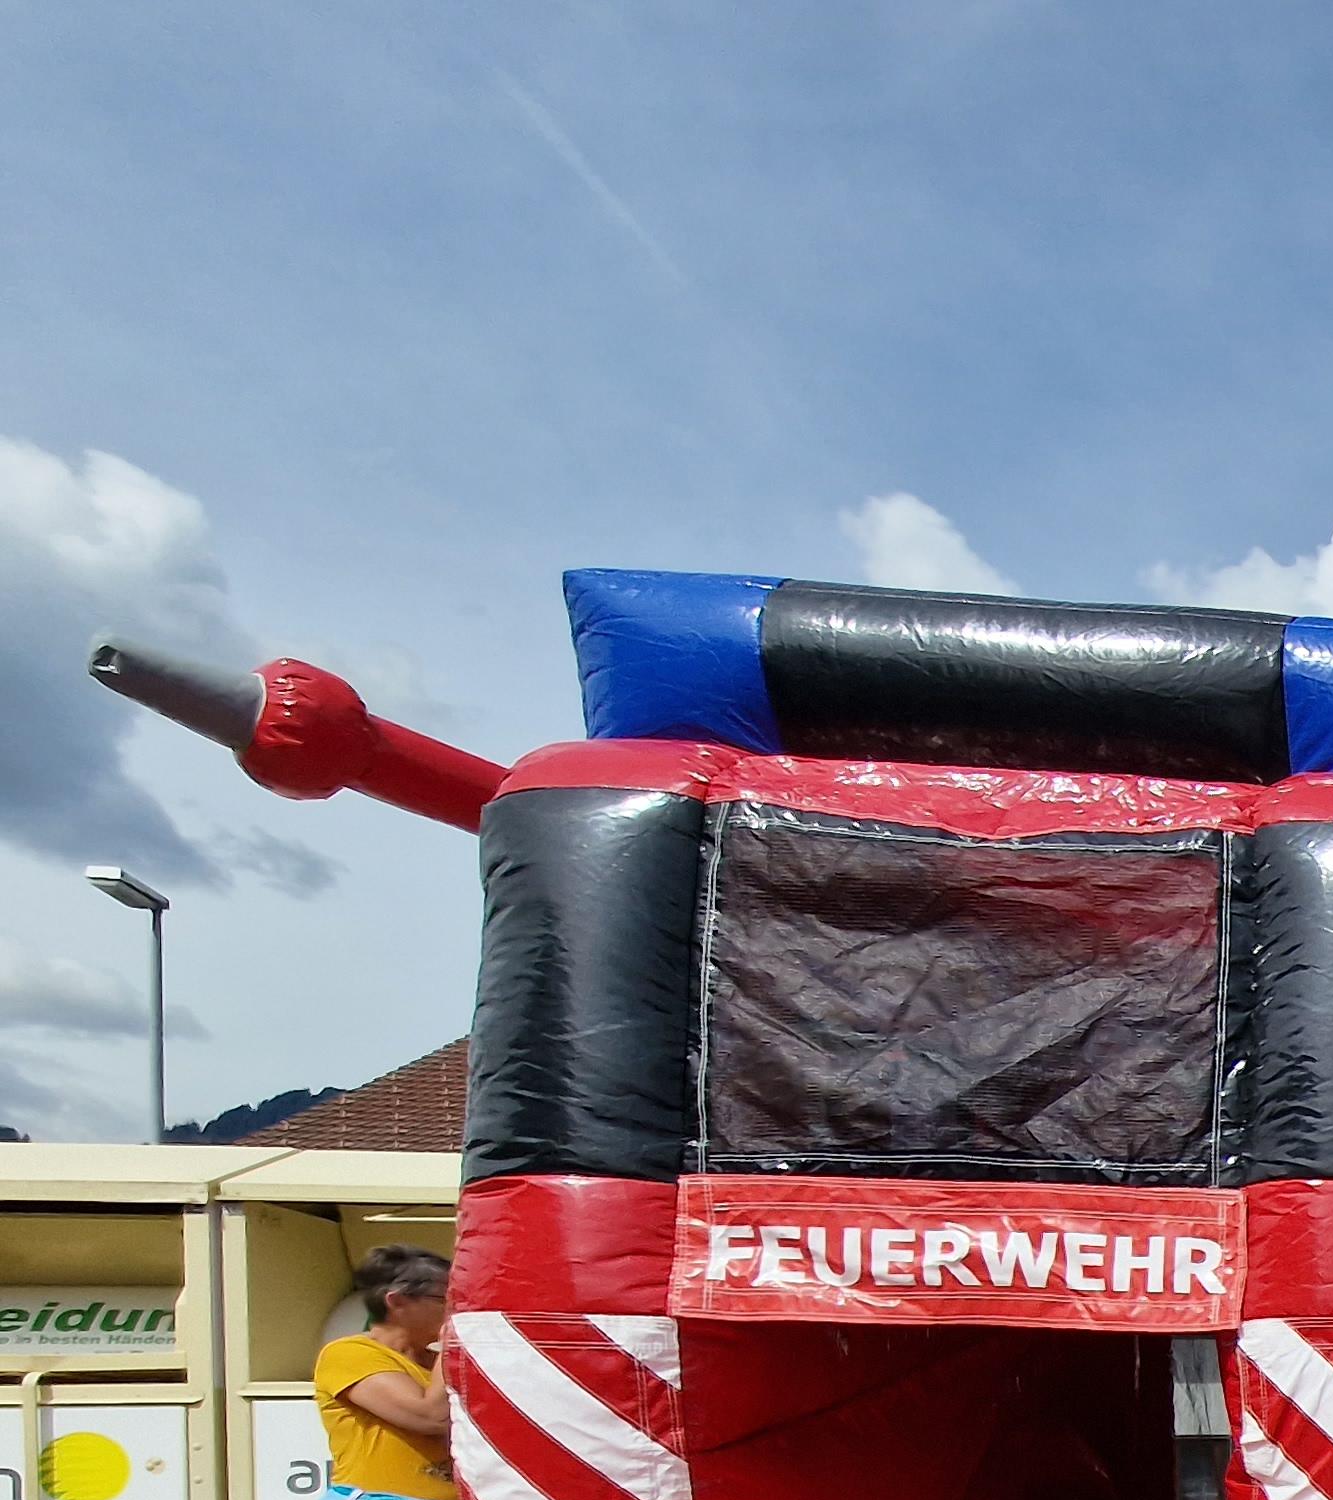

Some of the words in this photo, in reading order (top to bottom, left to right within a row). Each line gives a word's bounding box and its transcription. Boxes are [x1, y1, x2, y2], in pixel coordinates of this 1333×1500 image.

[705, 1223, 1228, 1295] FEUERWEHR
[39, 1334, 101, 1345] besten
[108, 1334, 177, 1345] Händen
